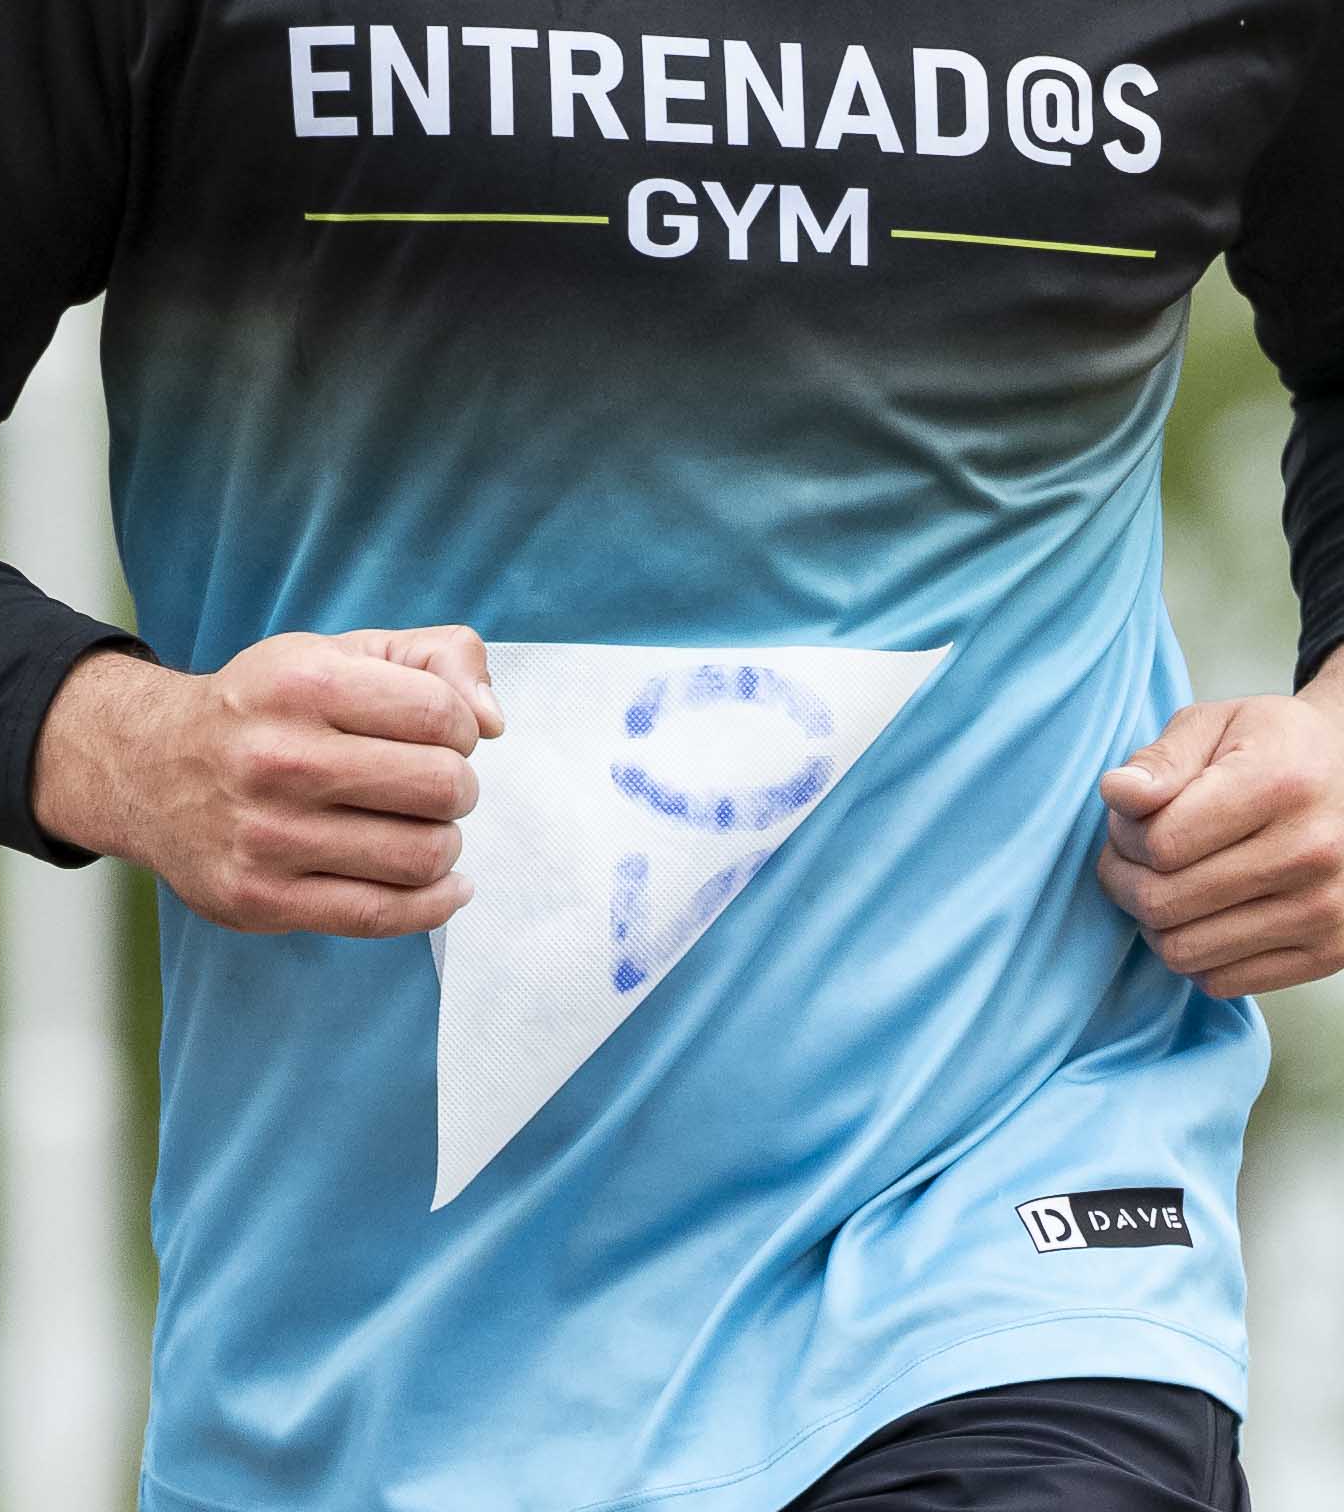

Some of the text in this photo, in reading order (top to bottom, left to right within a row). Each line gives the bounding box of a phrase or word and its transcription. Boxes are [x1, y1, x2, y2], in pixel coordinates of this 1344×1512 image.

[288, 25, 1163, 174] ENTRENAD@S
[626, 177, 870, 267] GYM
[1087, 1207, 1183, 1232] DAVE
